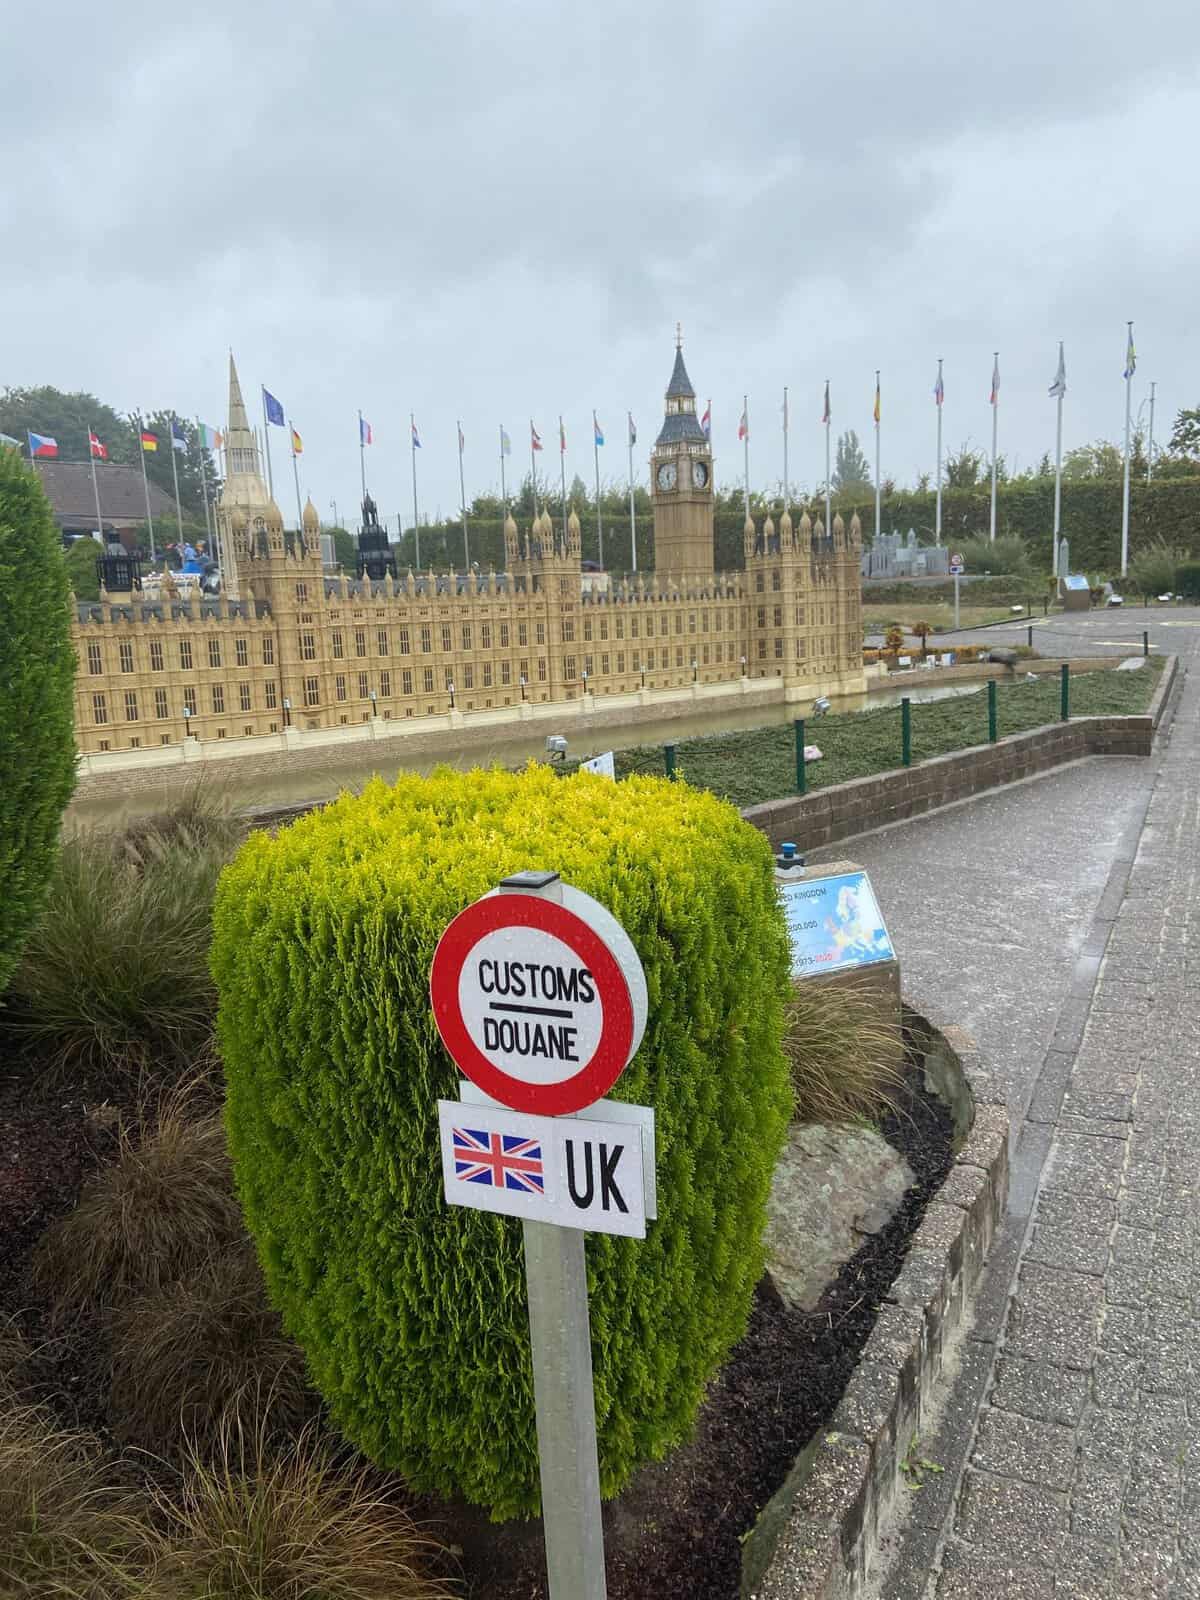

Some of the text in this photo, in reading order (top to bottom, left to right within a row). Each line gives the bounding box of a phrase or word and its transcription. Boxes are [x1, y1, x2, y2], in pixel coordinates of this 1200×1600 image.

[478, 959, 595, 1003] CUSTOMS
[483, 1017, 579, 1062] DOUANE
[565, 1139, 629, 1214] UK
